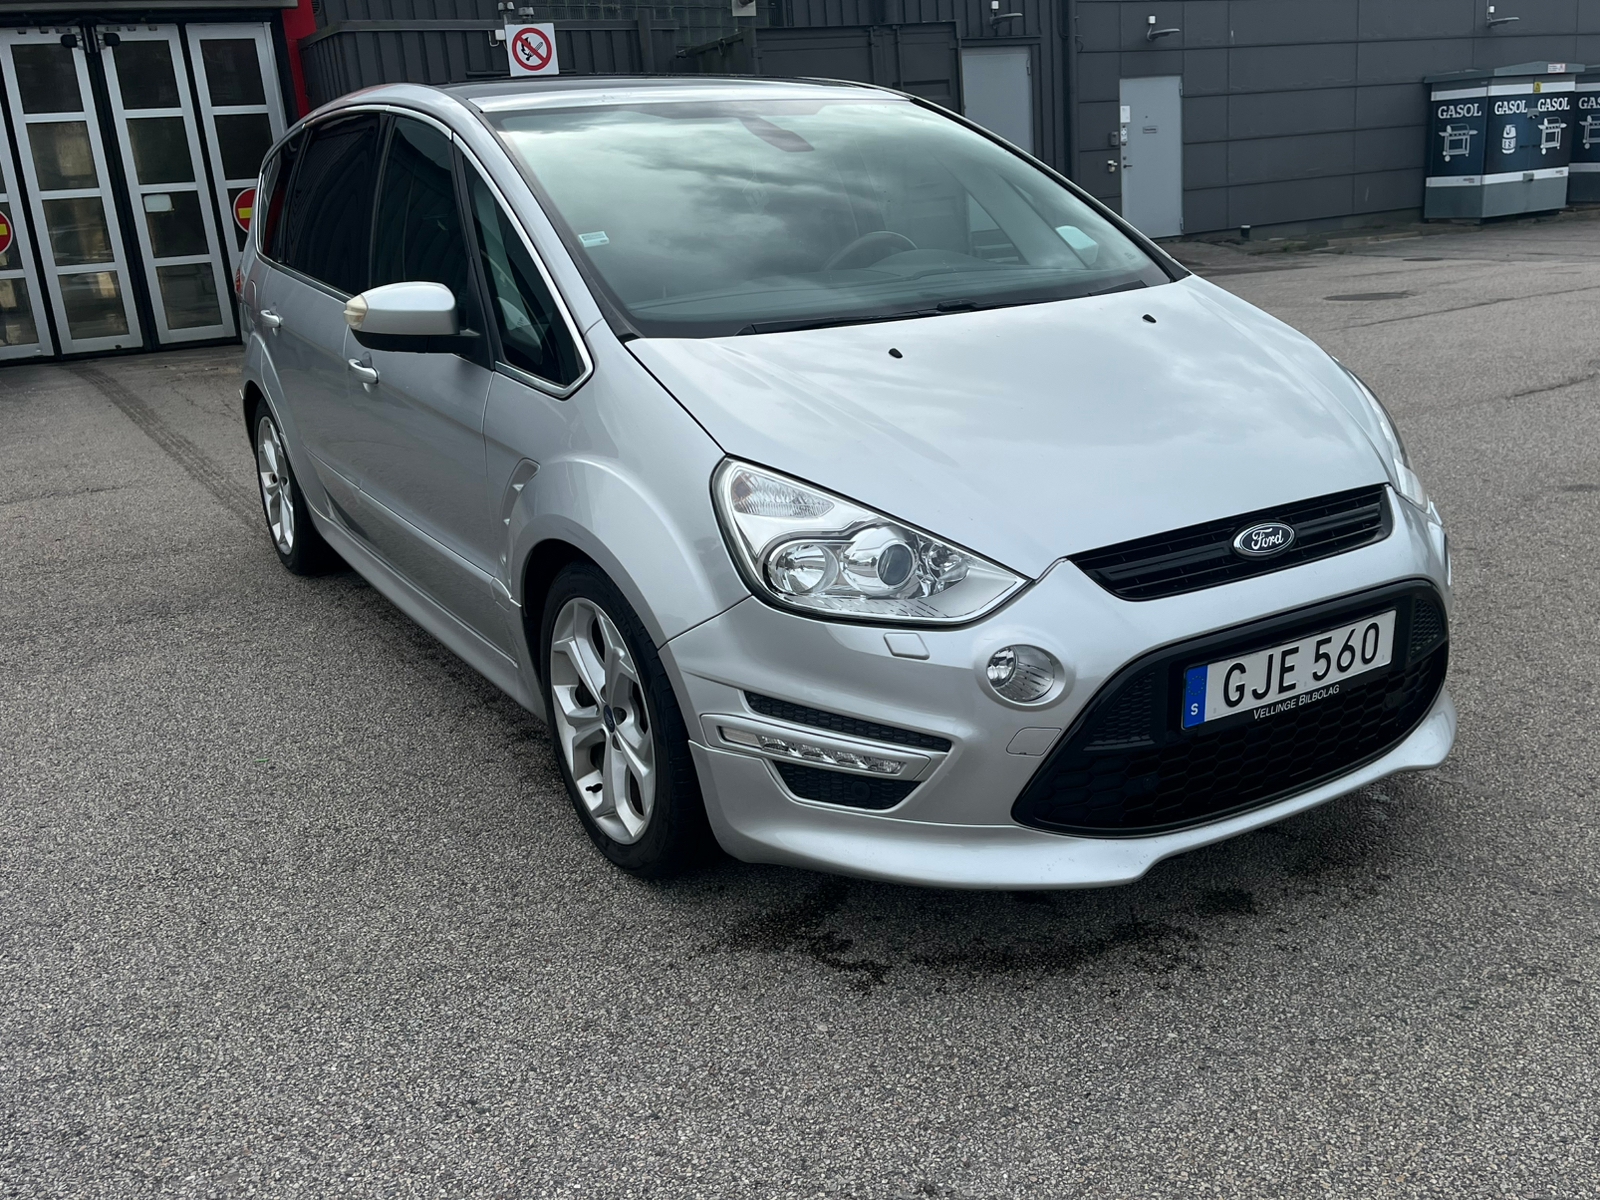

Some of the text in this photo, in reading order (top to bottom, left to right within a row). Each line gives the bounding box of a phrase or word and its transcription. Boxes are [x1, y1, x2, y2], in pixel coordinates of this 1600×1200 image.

[1438, 104, 1482, 119] GASOL
[1494, 100, 1528, 114] GASOL
[1537, 98, 1570, 111] GASOL
[1251, 528, 1284, 550] Ford
[1223, 622, 1380, 709] GJE 560
[1190, 703, 1199, 716] S
[1253, 685, 1340, 719] VELLINGE BILBOLAG
